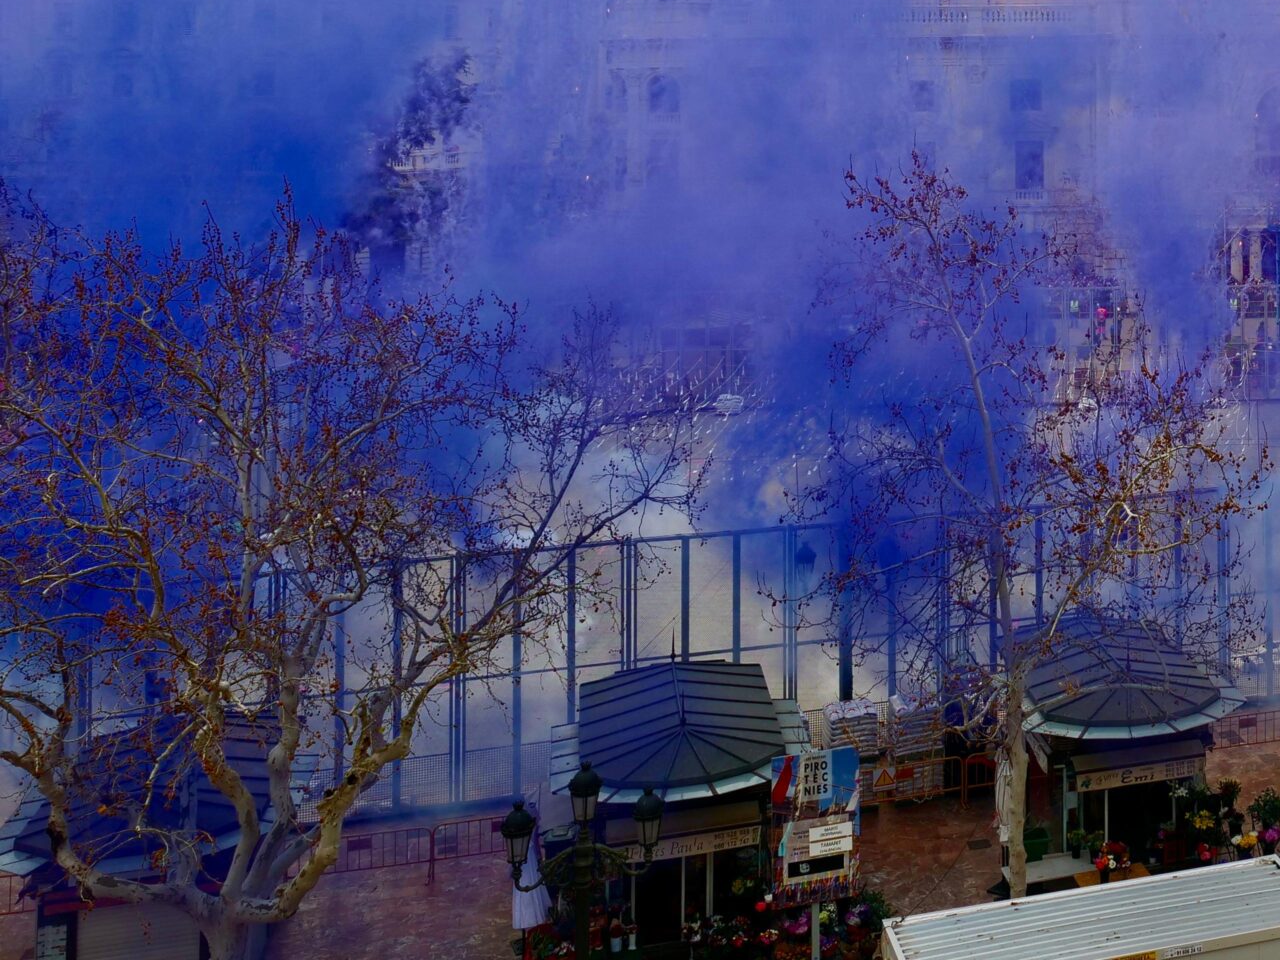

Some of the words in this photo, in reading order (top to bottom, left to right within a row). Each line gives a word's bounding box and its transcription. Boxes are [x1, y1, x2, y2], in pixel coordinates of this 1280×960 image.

[804, 760, 828, 773] PIRO
[804, 783, 828, 796] NIES
[670, 837, 704, 855] Paula
